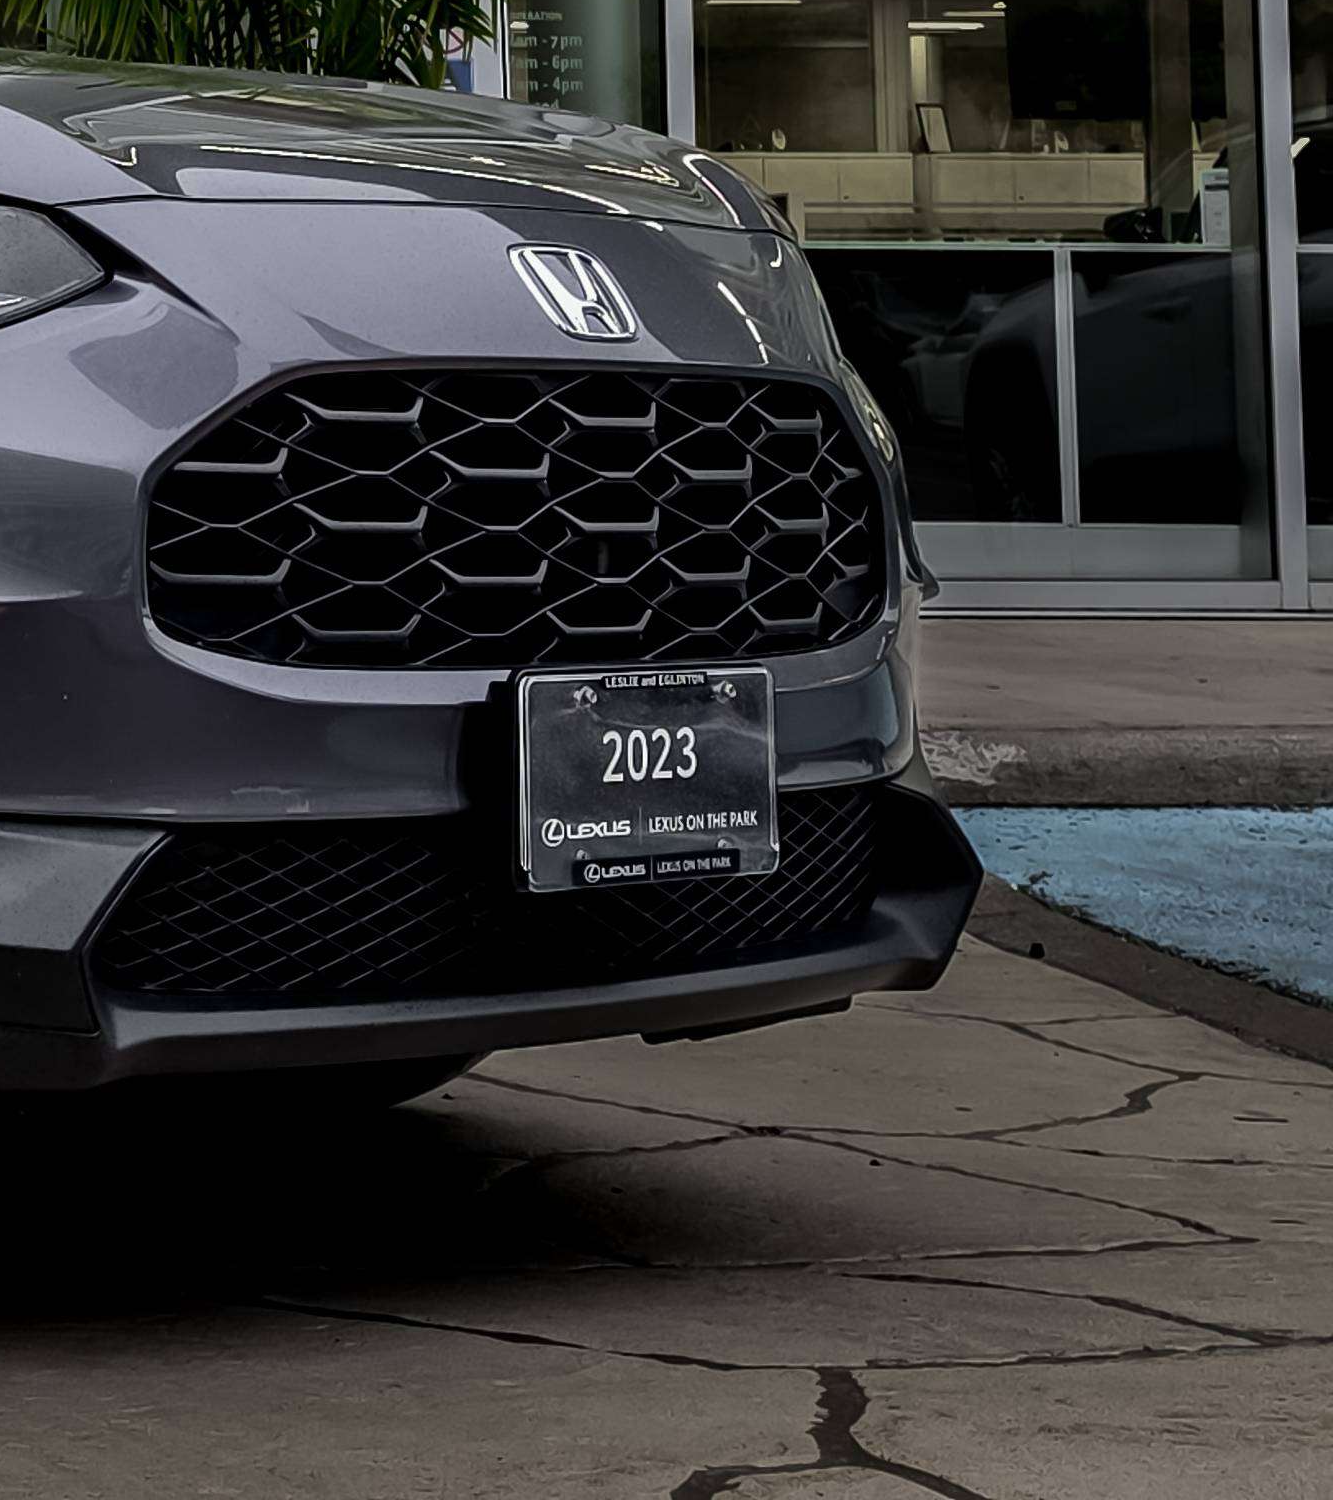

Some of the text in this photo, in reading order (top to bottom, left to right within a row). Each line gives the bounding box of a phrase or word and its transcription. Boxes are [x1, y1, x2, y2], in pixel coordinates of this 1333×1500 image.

[604, 676, 640, 688] LESLIE
[641, 676, 657, 687] and
[602, 726, 697, 783] 2023
[566, 809, 759, 840] LEXUS LEXUS ON THE PARK
[601, 856, 732, 879] LEXUS LEXUS ON THE PARK
